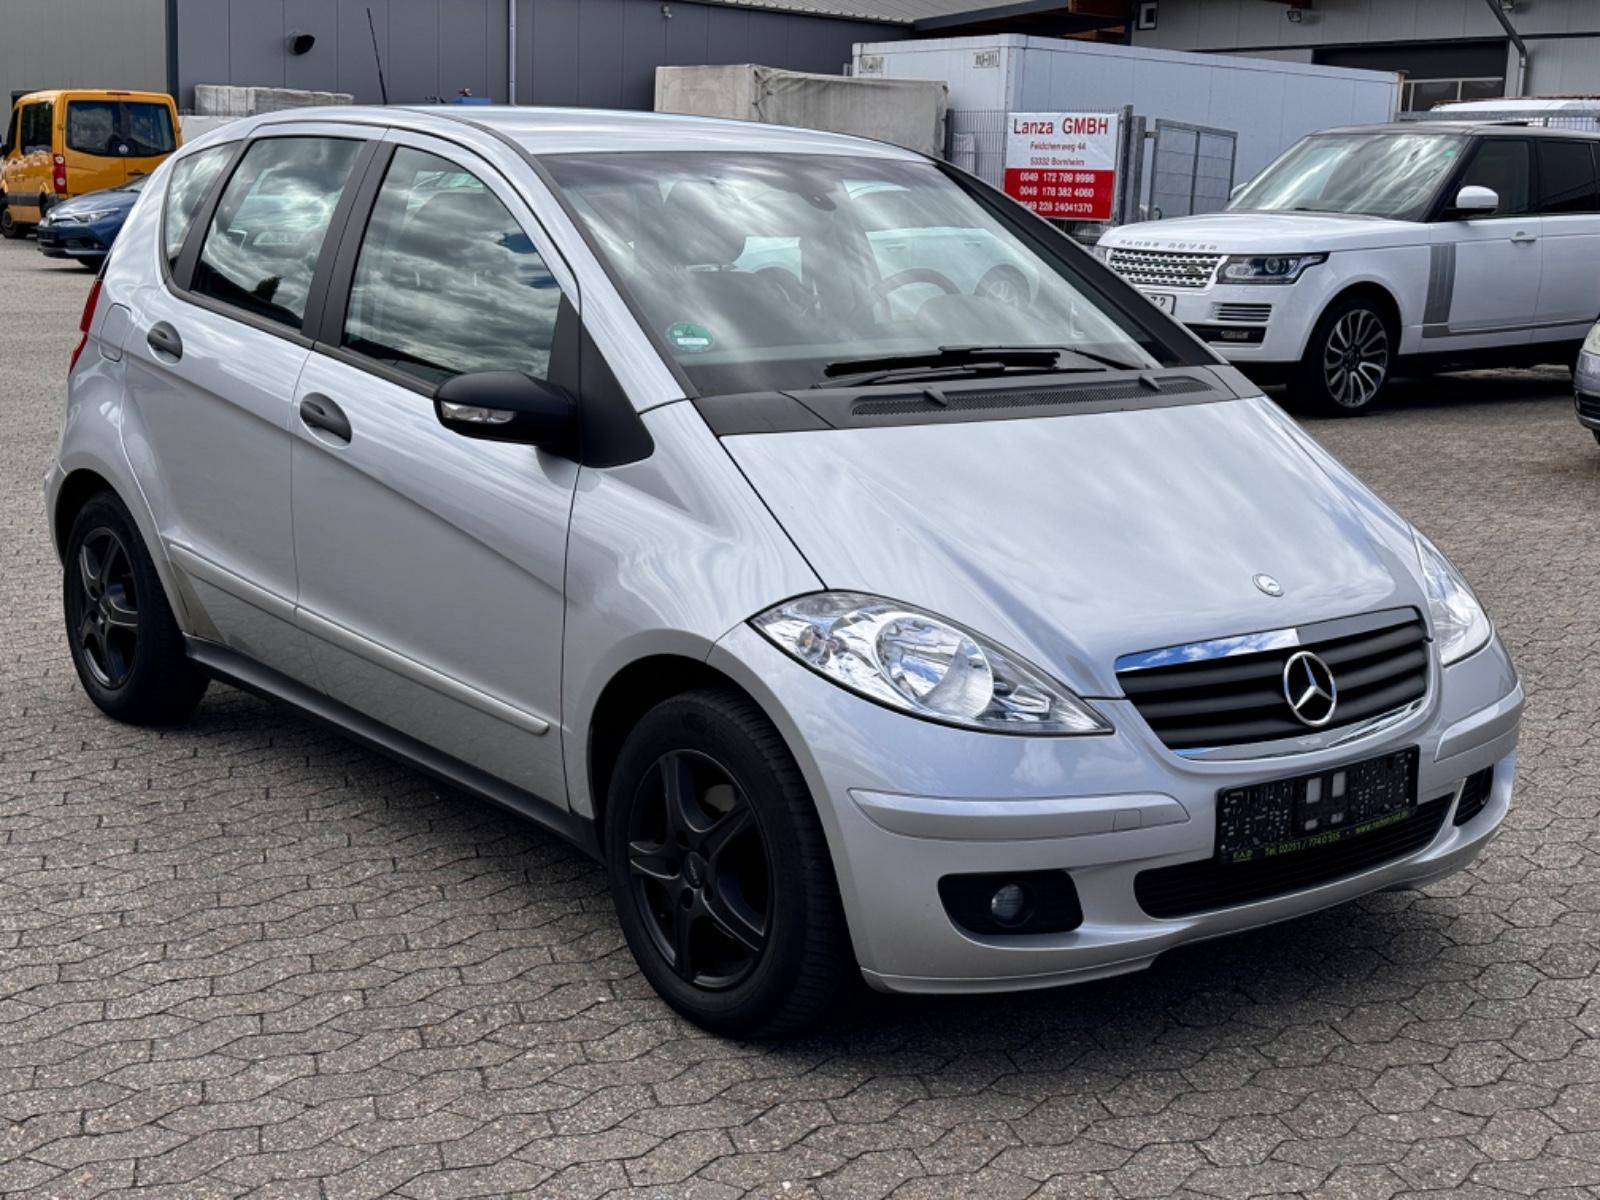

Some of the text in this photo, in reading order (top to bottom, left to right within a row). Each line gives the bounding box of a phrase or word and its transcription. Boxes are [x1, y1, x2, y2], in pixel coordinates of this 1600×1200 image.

[1013, 117, 1109, 135] Lanza GMBH
[1030, 157, 1085, 166] 53332 Bornheim
[1020, 172, 1039, 182] 0049
[1043, 172, 1057, 183] 172
[1019, 186, 1038, 196] 0049
